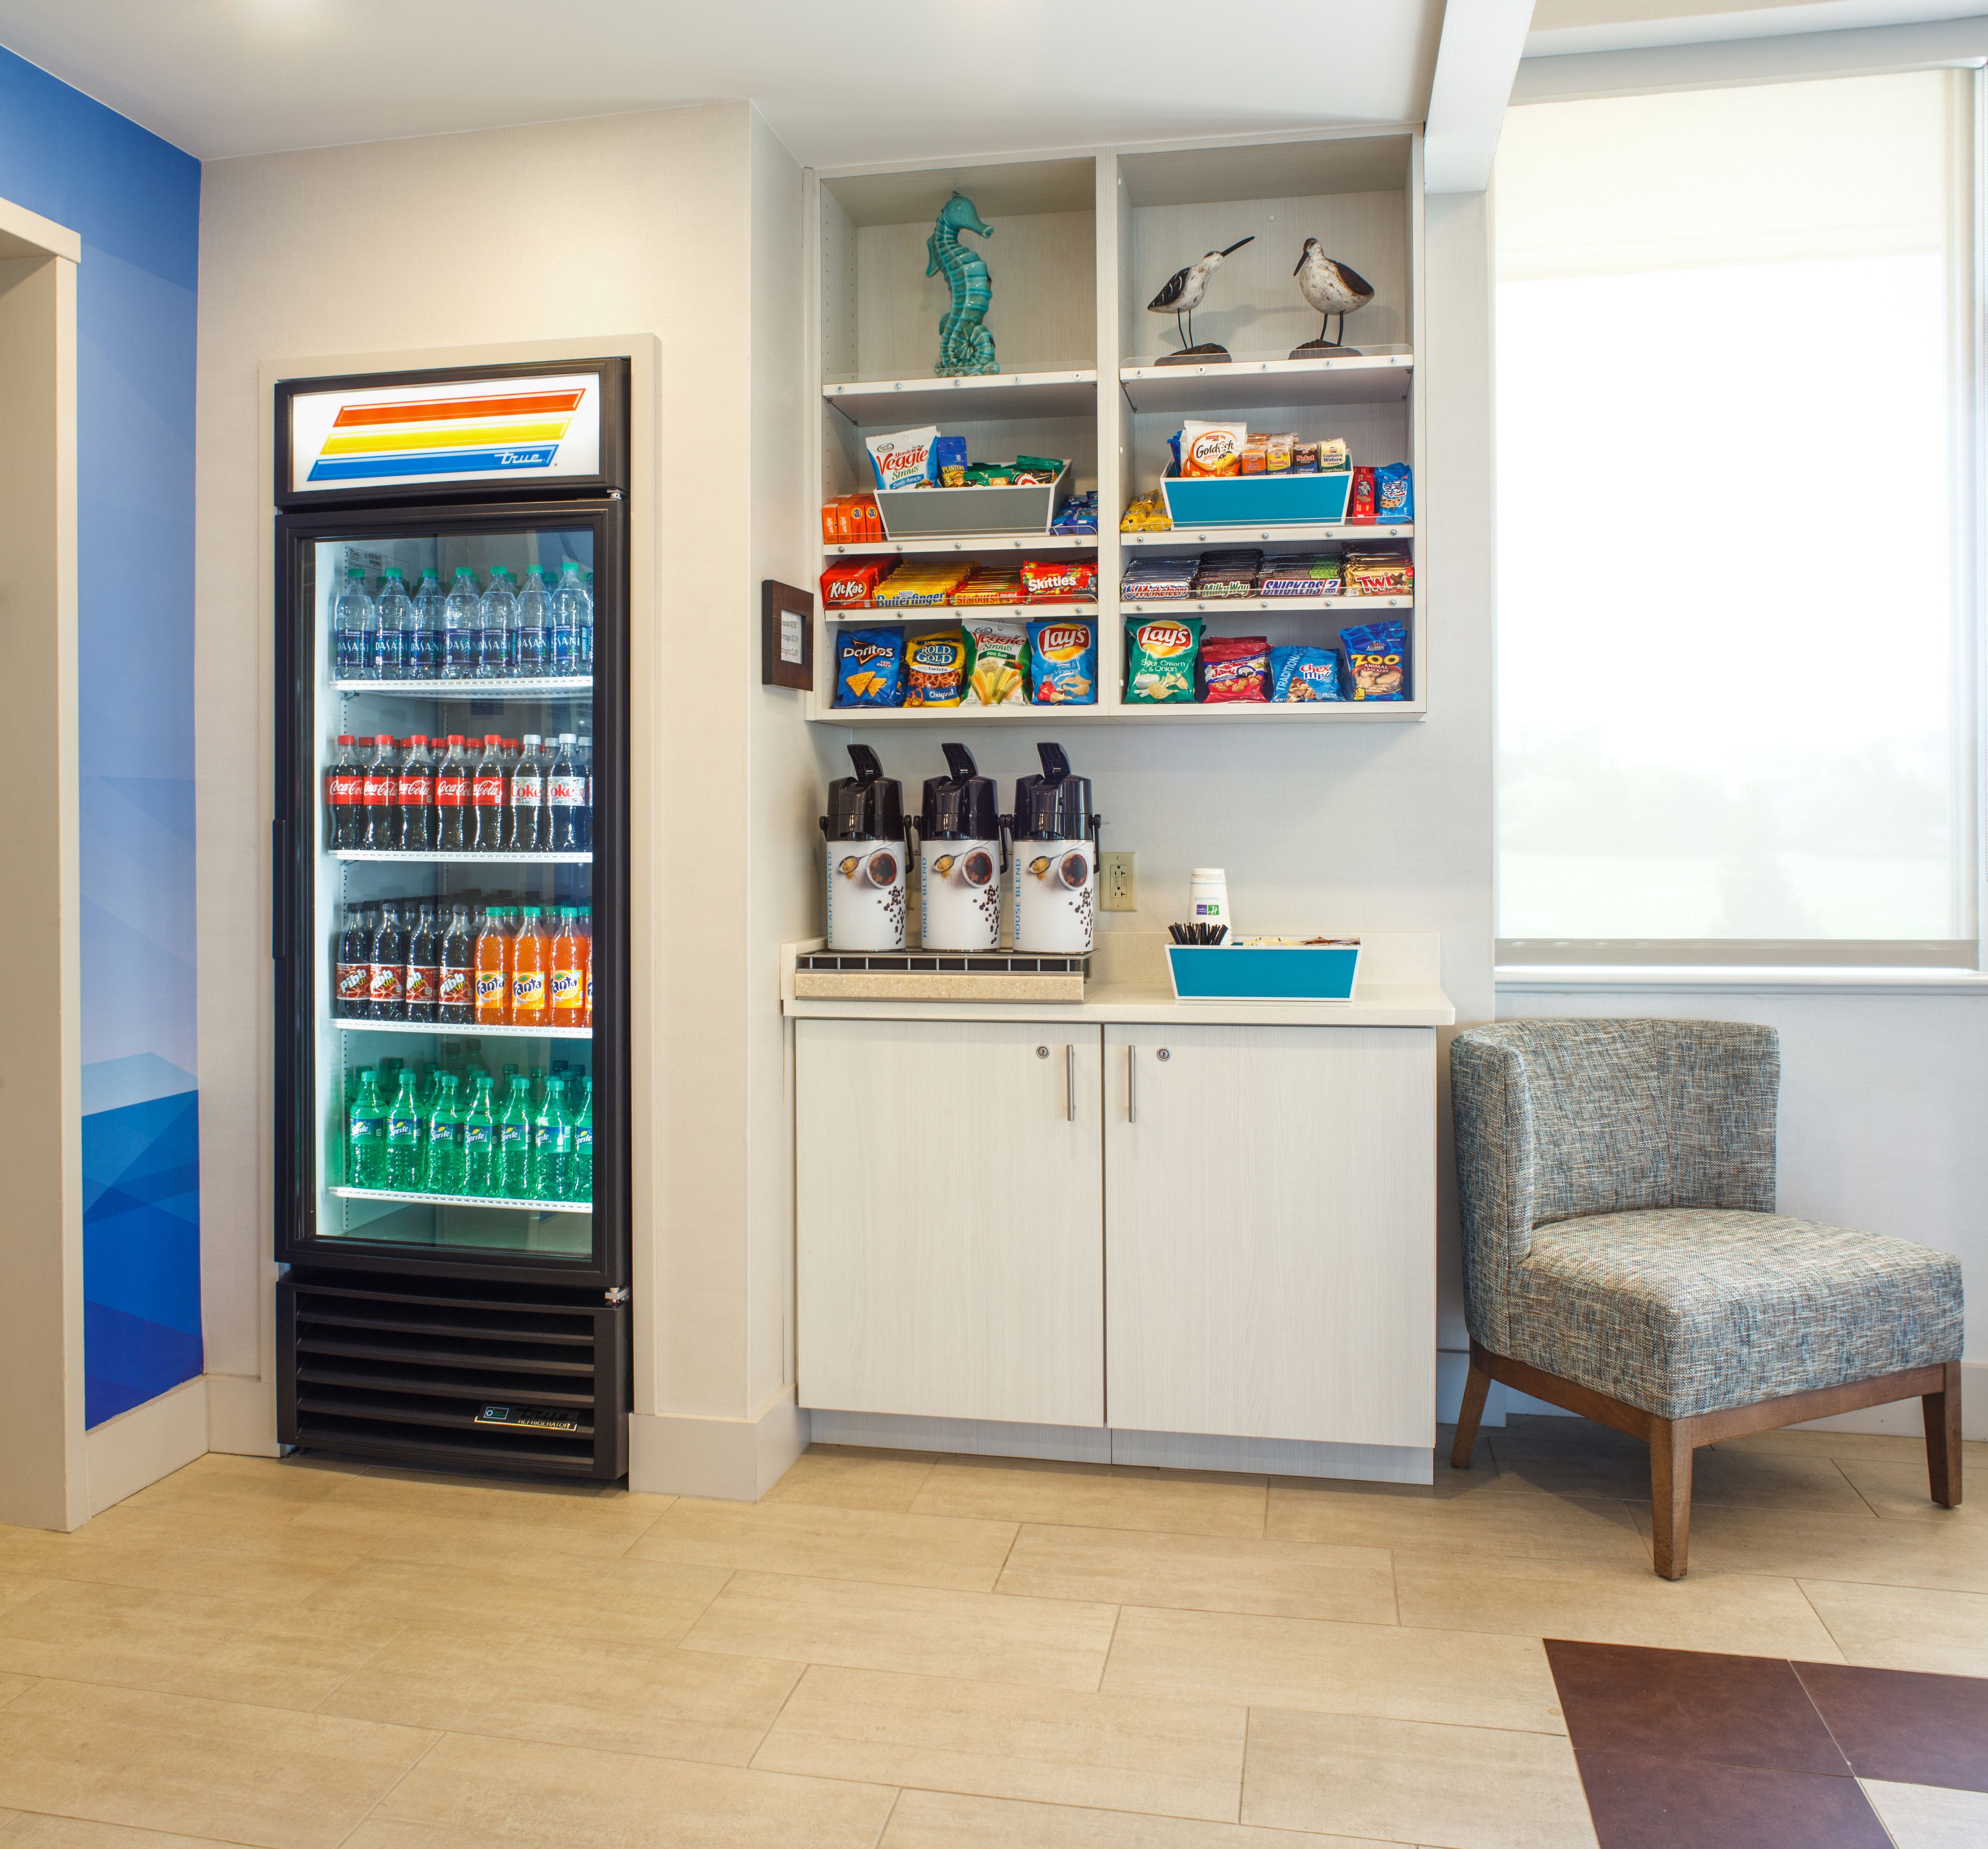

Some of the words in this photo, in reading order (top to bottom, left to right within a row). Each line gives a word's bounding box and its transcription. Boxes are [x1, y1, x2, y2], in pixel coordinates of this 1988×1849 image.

[875, 449, 929, 476] Veggie
[942, 465, 965, 473] PLANTERS
[892, 465, 919, 481] Straws
[892, 479, 905, 489] Zesty
[1028, 576, 1077, 592] Skittles
[1262, 580, 1324, 595] SNICKERS
[1135, 585, 1189, 599] Musketeers
[876, 592, 945, 607] Butterfinger
[957, 593, 999, 605] Starburst
[972, 632, 1026, 649] Veggie
[1043, 628, 1087, 652] Lay's
[1141, 627, 1188, 647] Lay's
[337, 639, 369, 653] DASANI
[375, 639, 407, 652] DASANI
[411, 639, 443, 653] DASANI
[448, 638, 479, 651] DASANI
[921, 646, 952, 655] ROLD
[983, 643, 1013, 651] Straws
[843, 645, 894, 658] Doritos
[916, 652, 953, 663] GOLD
[1141, 659, 1158, 667] Sour
[1350, 654, 1401, 667] ZOO
[1212, 668, 1236, 678] Jack
[1299, 663, 1333, 673] Chex
[929, 686, 954, 699] Original
[510, 784, 542, 797] Coke
[340, 969, 367, 994] Pibb
[440, 972, 465, 998] Pibb
[390, 1125, 409, 1137] Sprite
[430, 1129, 450, 1140] Sprite
[466, 1132, 485, 1143] Sprite
[501, 1131, 518, 1142] Sprite
[518, 1419, 571, 1429] REFRIGERATOR
